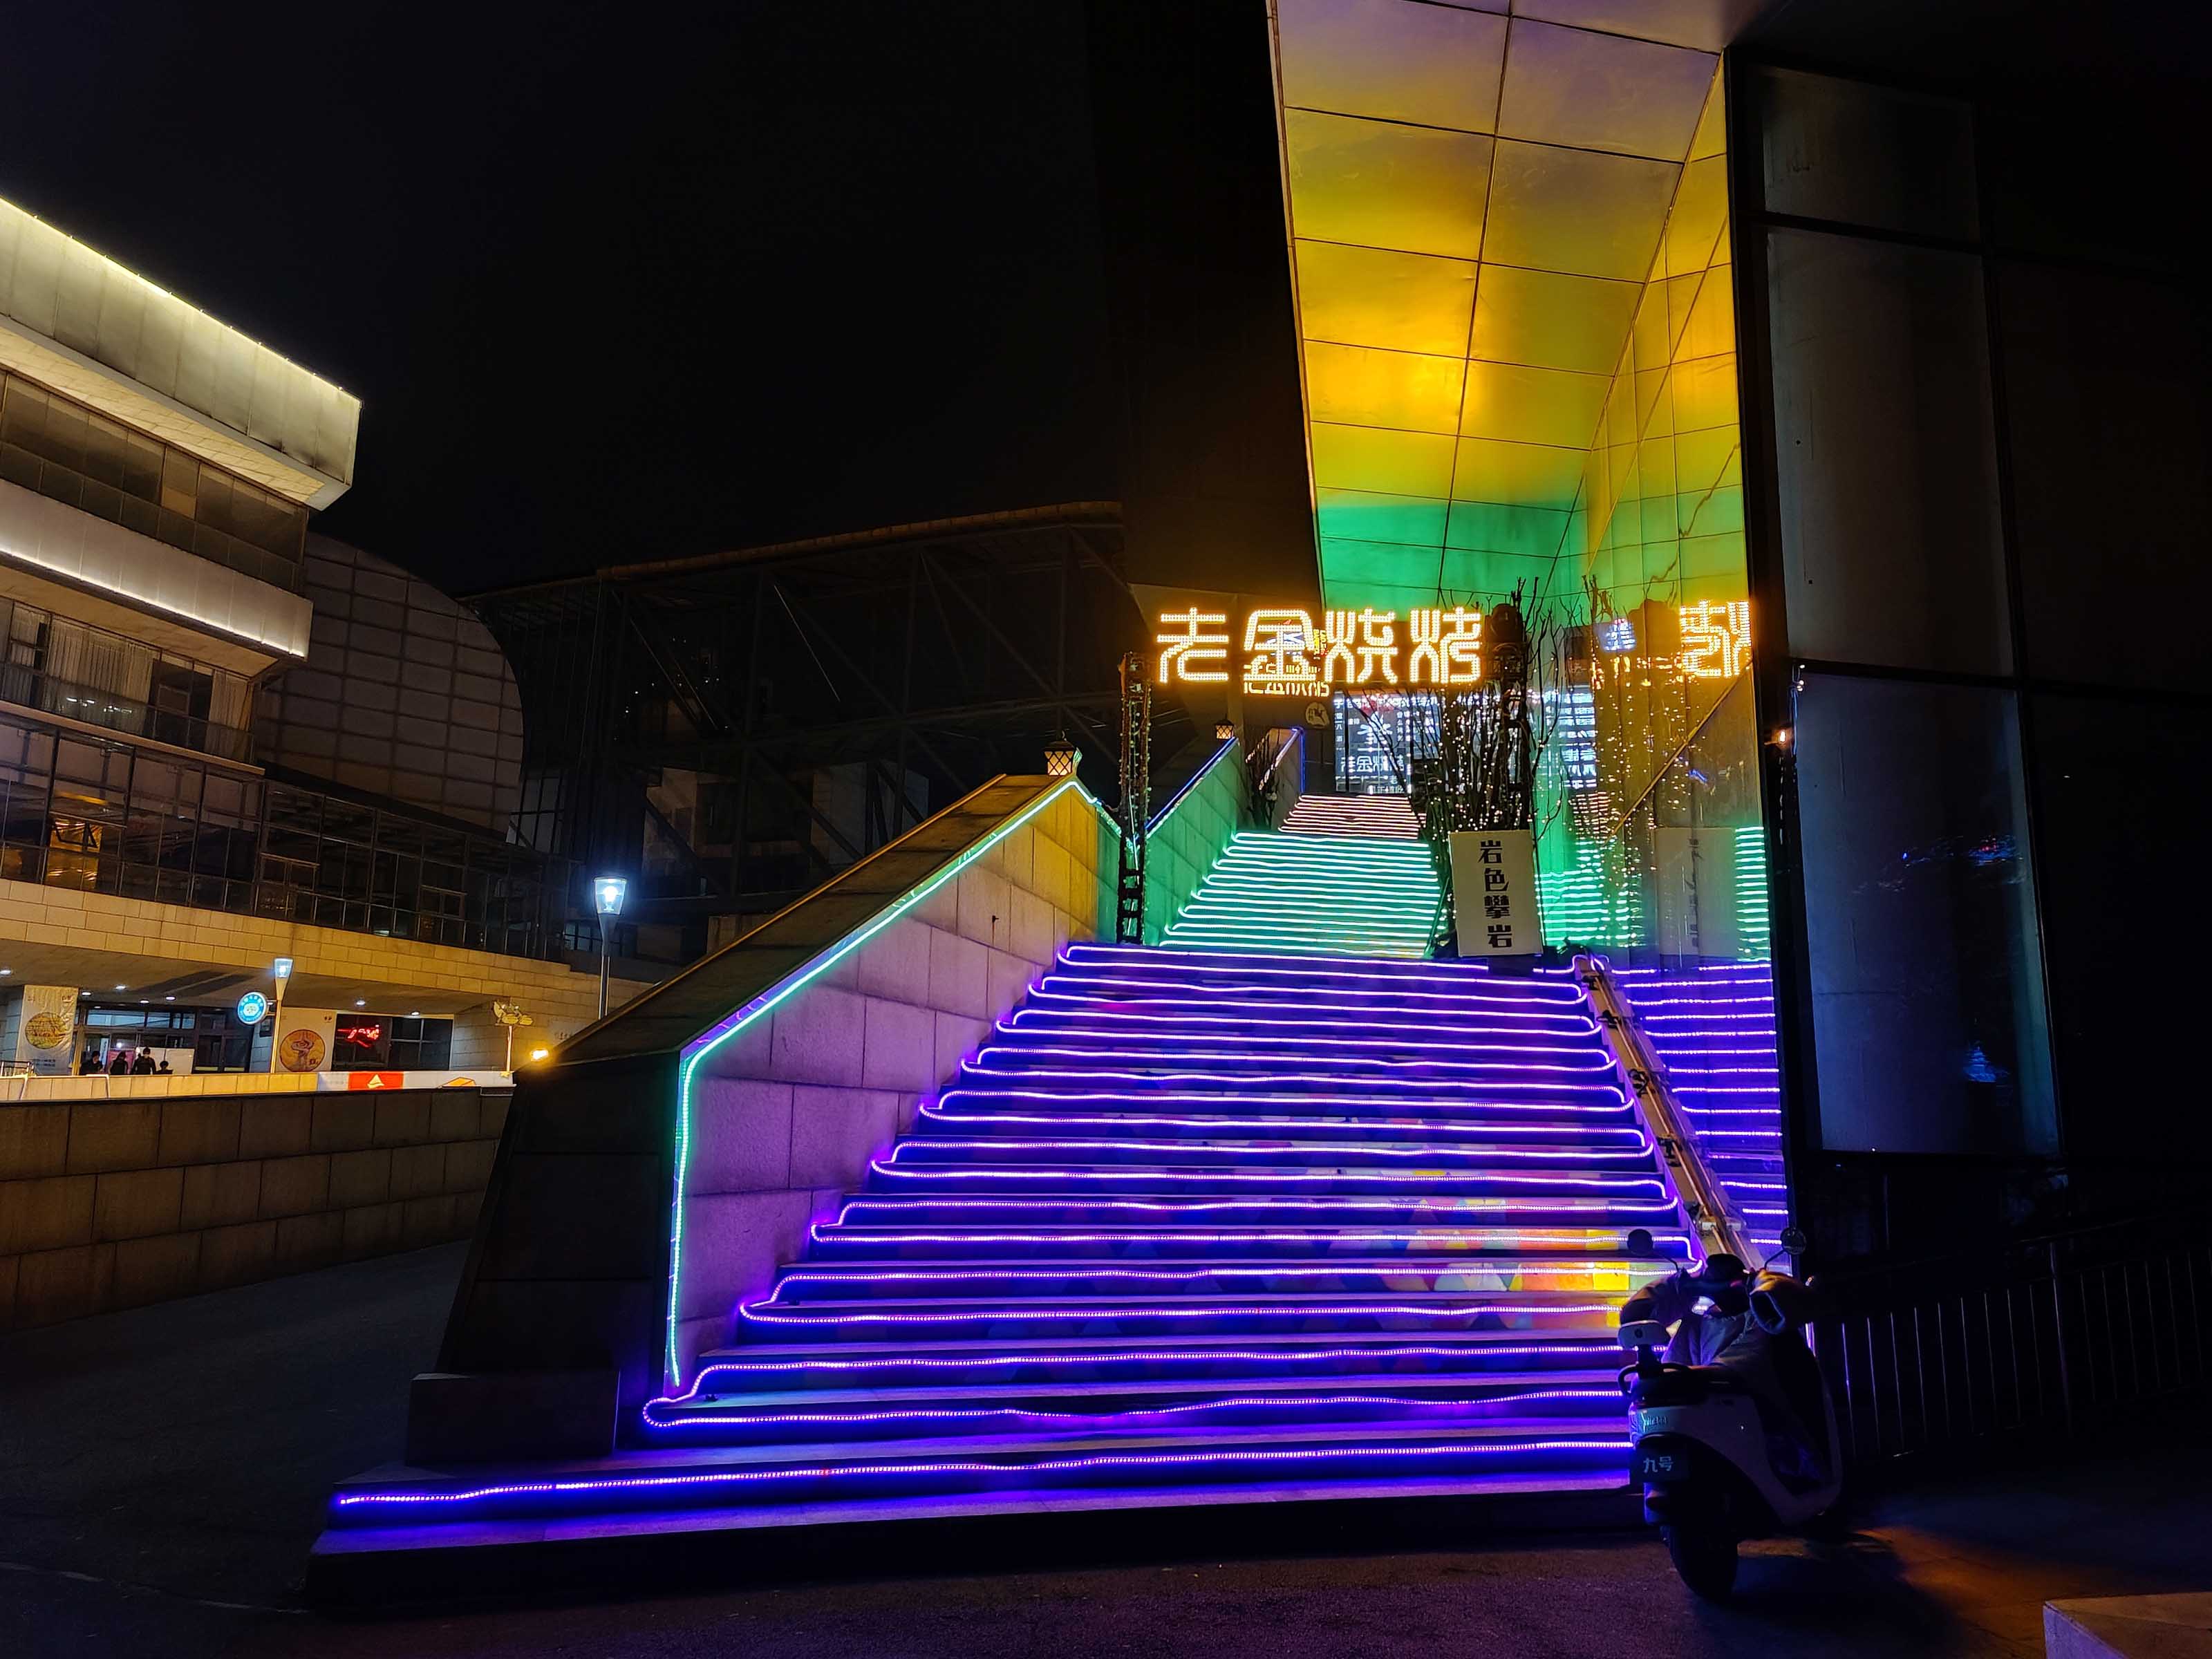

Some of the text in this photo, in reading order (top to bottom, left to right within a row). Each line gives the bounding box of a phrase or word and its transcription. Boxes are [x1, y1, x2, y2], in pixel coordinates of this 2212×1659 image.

[1156, 606, 1482, 684] 老金烧烤
[1477, 839, 1512, 948] 岩色攀岩
[1643, 1456, 1674, 1473] 九号
